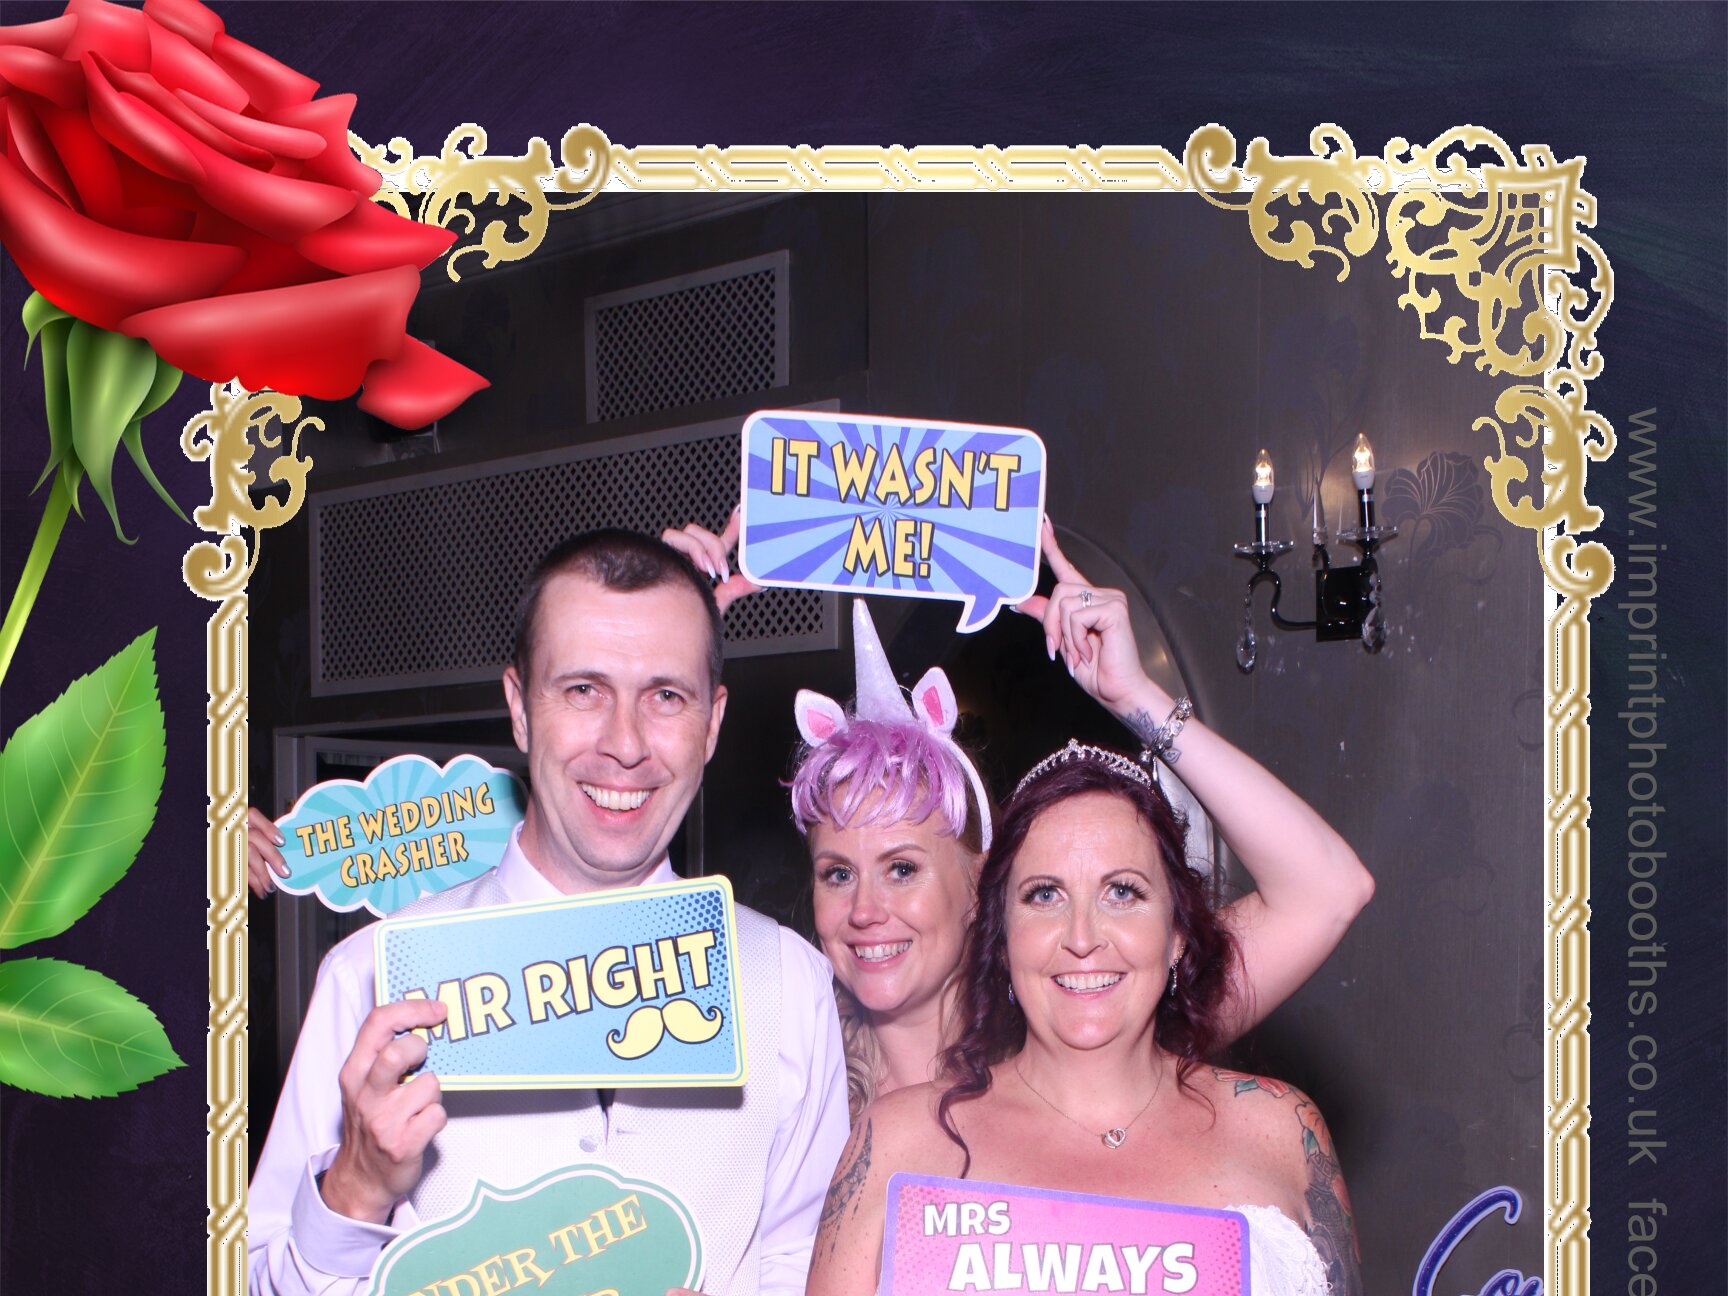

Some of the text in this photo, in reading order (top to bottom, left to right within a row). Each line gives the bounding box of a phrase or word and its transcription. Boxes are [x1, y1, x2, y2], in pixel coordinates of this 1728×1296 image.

[770, 437, 1021, 511] IT WASN'T
[843, 515, 935, 578] ME!
[295, 782, 495, 857] THE WEDDING
[340, 831, 469, 888] CRASHER
[403, 929, 717, 1044] MR RIGHT
[548, 1194, 648, 1265] THE
[923, 1201, 1011, 1237] MRS
[947, 1242, 1199, 1296] ALWAYS
